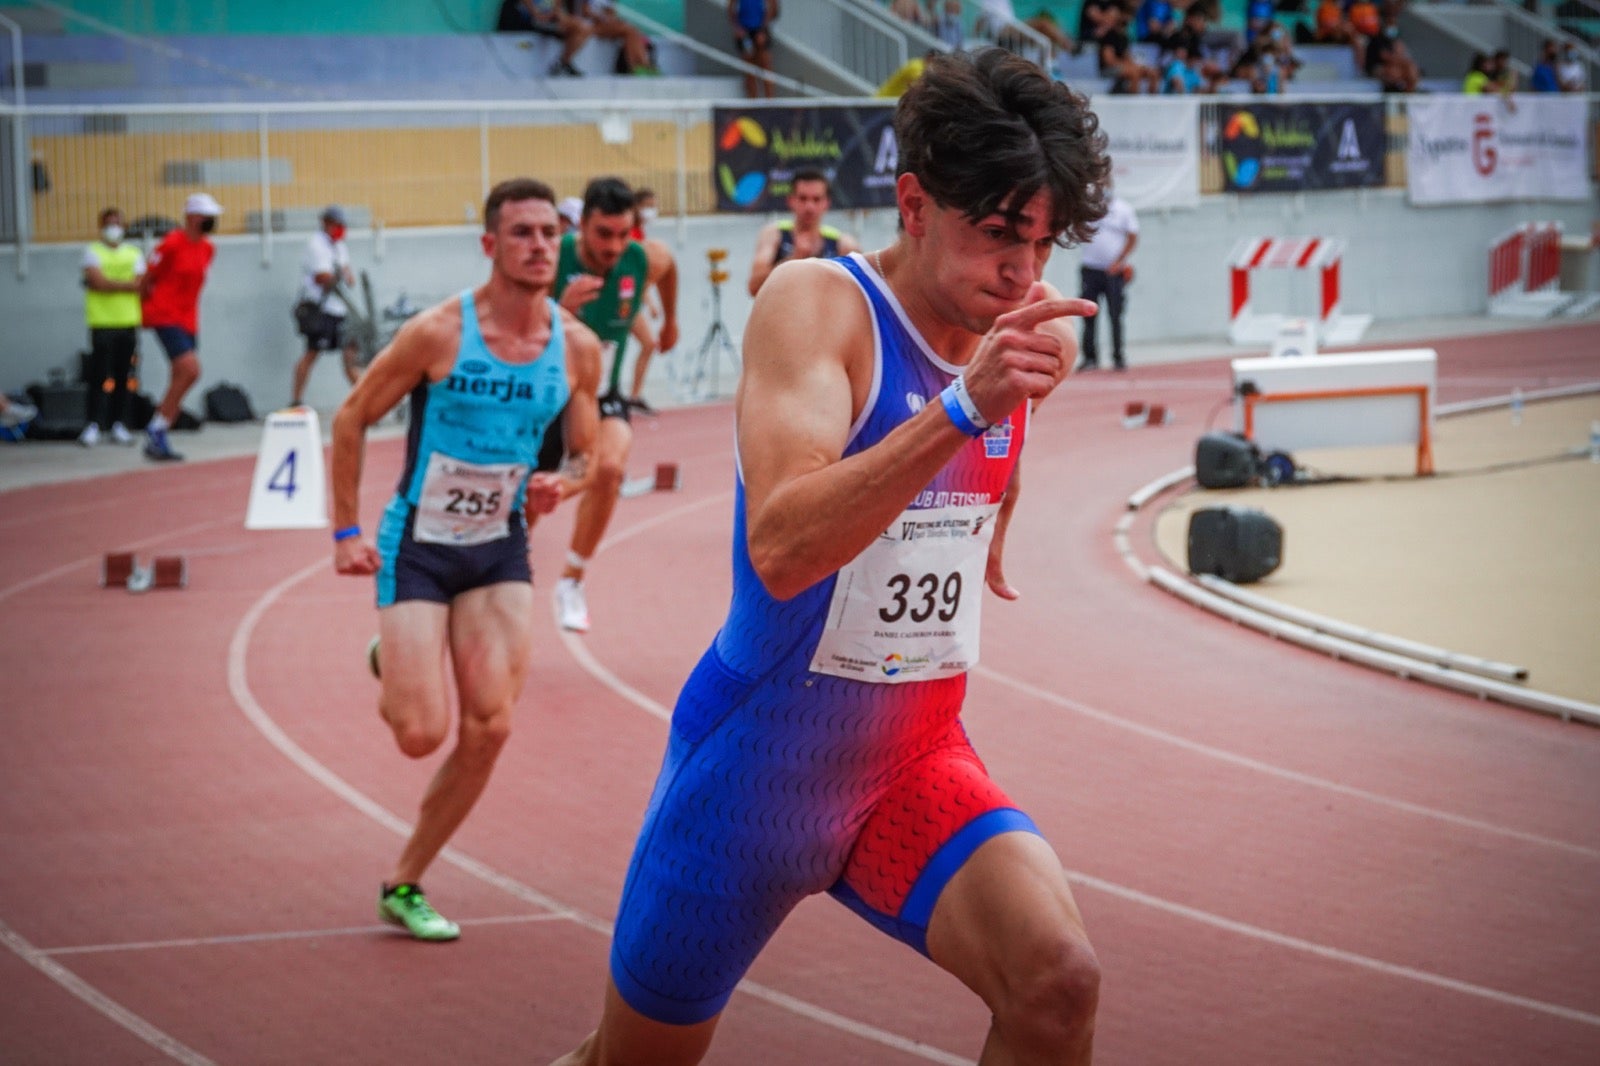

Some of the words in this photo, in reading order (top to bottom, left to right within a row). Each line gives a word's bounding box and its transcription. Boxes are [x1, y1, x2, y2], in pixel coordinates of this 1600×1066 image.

[446, 374, 534, 402] nerja
[267, 449, 297, 500] 4
[444, 487, 502, 516] 255
[933, 491, 991, 508] ATLETISMO
[879, 571, 962, 623] 339
